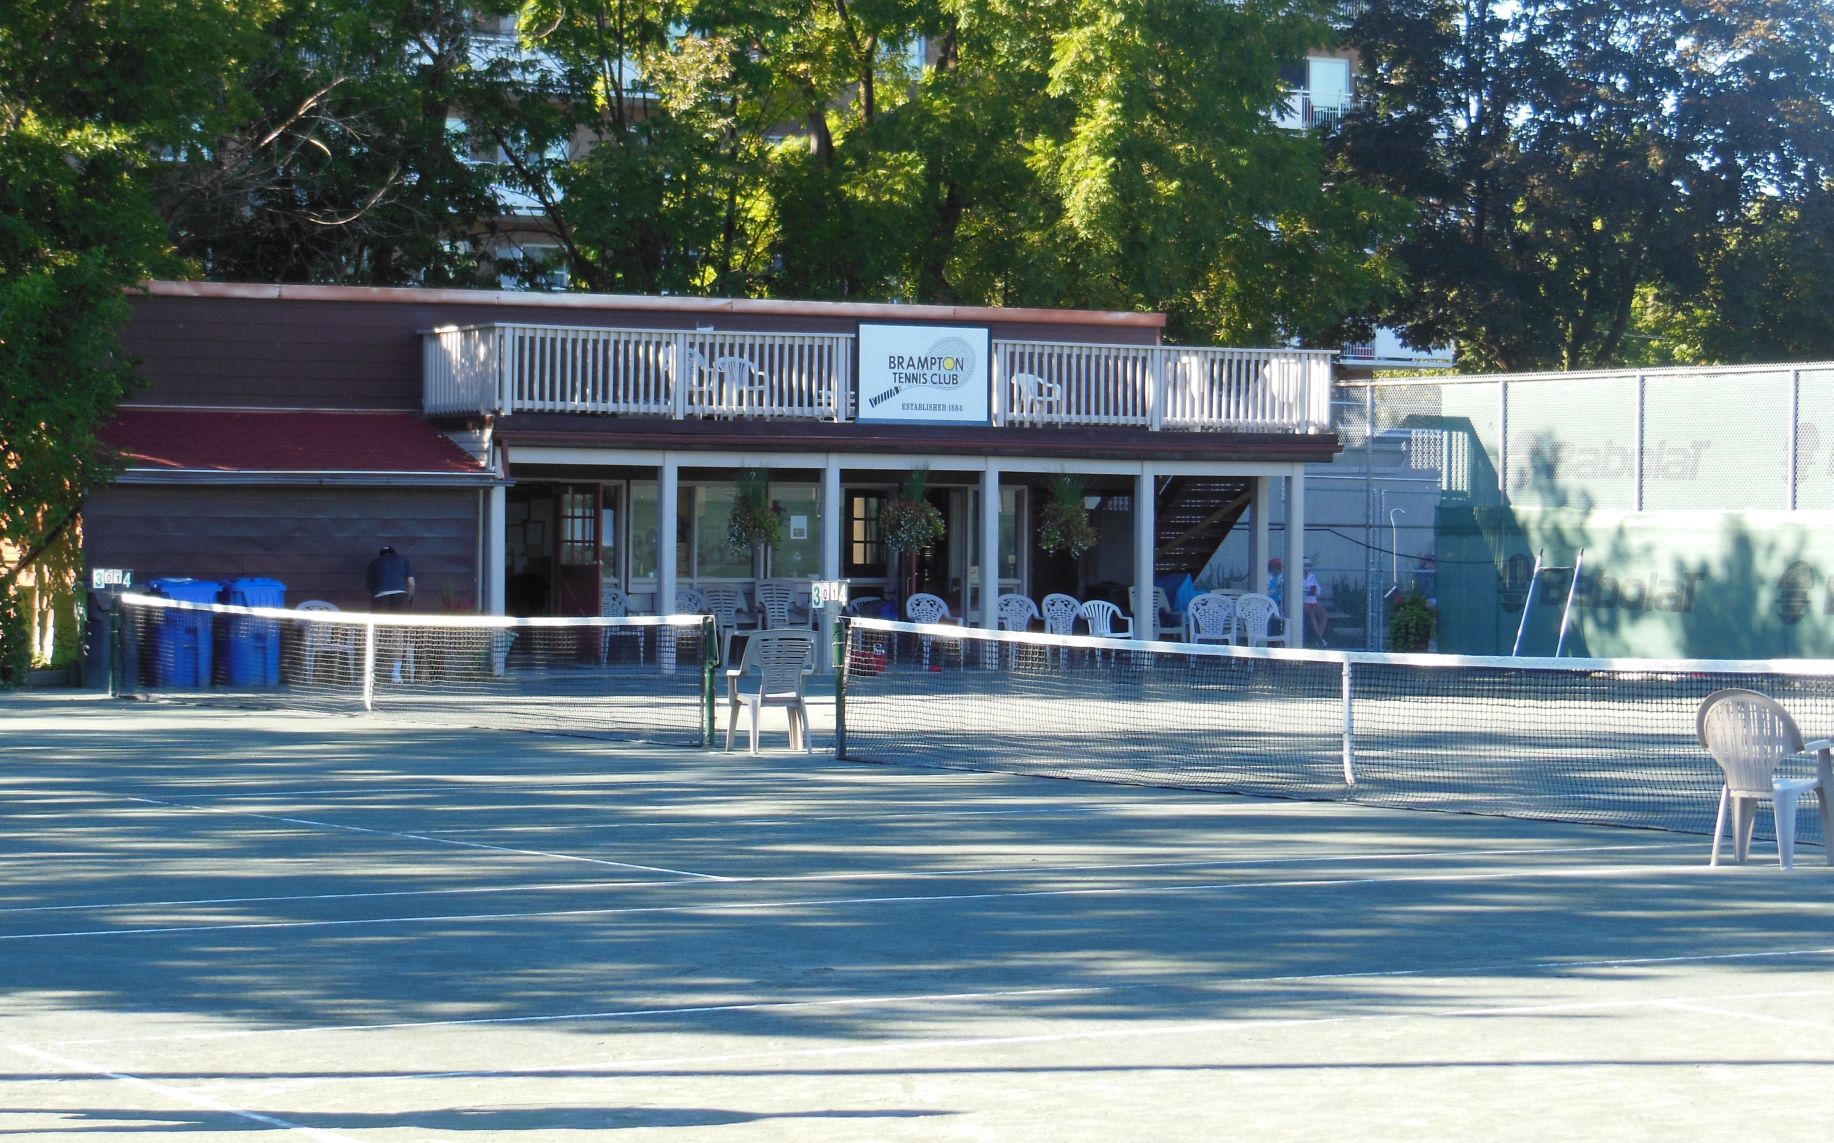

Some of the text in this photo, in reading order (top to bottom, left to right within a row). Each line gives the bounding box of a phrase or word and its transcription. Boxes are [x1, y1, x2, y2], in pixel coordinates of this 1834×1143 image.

[888, 355, 964, 371] BRAMPTON
[892, 372, 959, 385] TENNIS CLUB
[901, 403, 947, 412] ESTABLISHED
